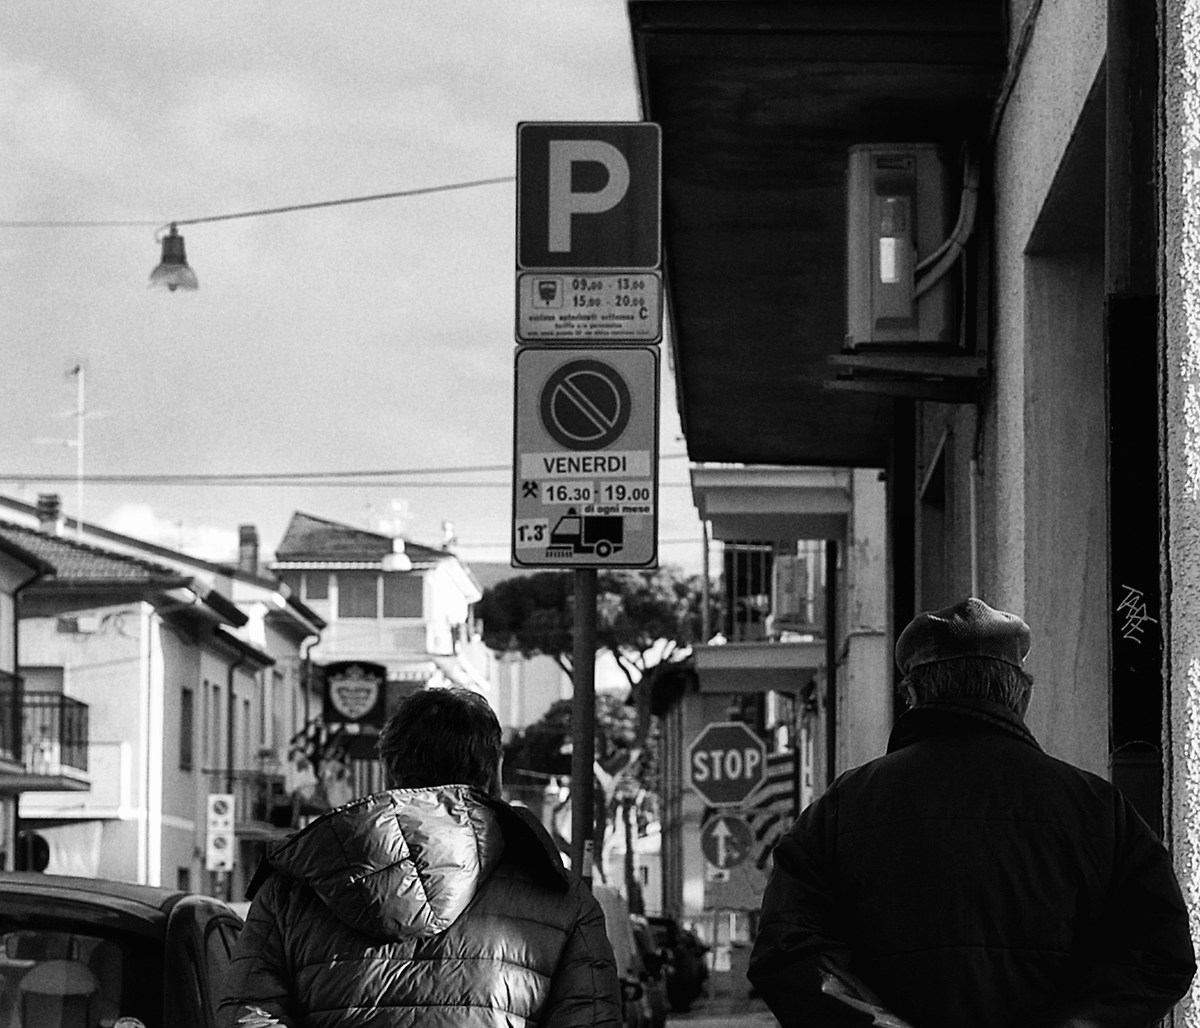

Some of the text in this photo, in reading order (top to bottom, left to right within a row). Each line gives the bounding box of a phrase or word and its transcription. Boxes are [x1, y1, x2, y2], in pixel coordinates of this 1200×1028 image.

[549, 140, 630, 252] P
[543, 456, 627, 474] VENERDI
[546, 485, 591, 501] 16.30
[604, 484, 650, 501] 19.00
[584, 504, 651, 515] di ogni mese
[693, 748, 760, 781] STOP
